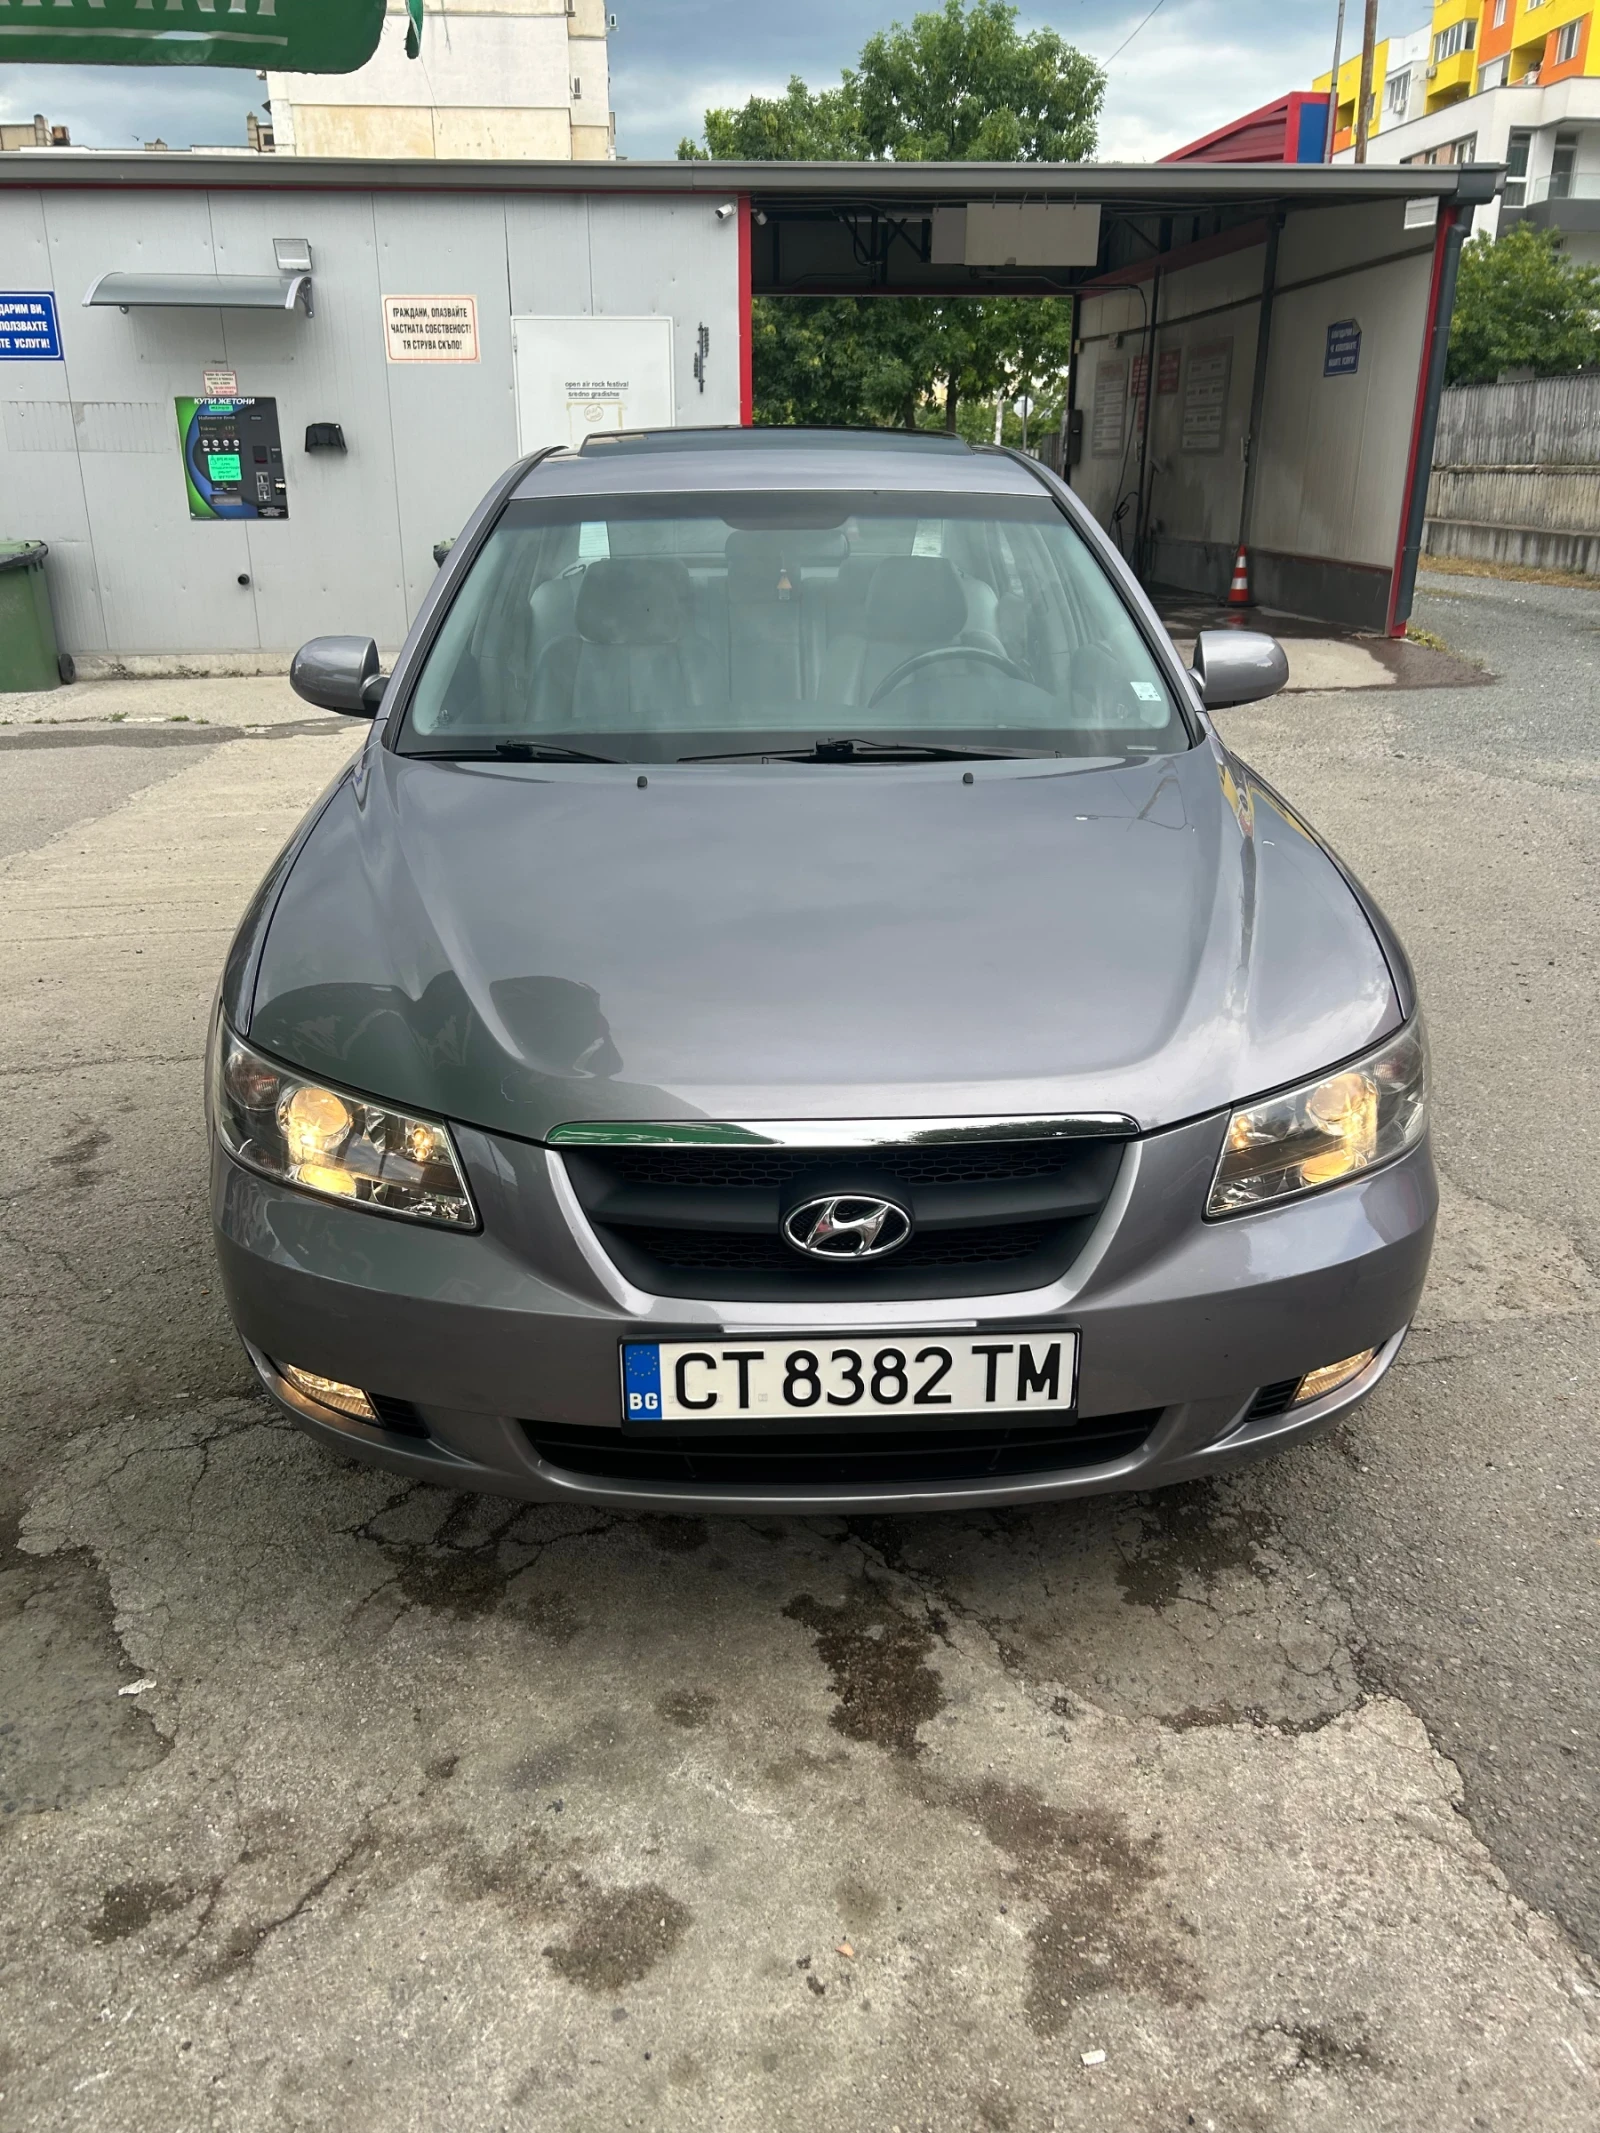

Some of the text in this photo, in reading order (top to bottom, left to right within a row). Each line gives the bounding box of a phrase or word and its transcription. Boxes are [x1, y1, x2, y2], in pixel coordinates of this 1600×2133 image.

[30, 304, 46, 316] ВИ,
[392, 305, 468, 319] ГРАЖДАНИ, ОПАЗВАЙТЕ
[390, 324, 472, 334] ЧАСТНАТА СОБСТВЕНОСТ!
[14, 338, 50, 348] УСЛУГИ!
[402, 340, 463, 350] ТЯ СТРУВА СКЪПО!
[582, 380, 591, 388] air
[591, 380, 605, 388] rock
[606, 380, 629, 388] festival
[193, 397, 256, 405] КУПИ ЖЕТОНИ
[674, 1342, 1062, 1410] CT 8382 TM
[629, 1392, 659, 1411] BG
